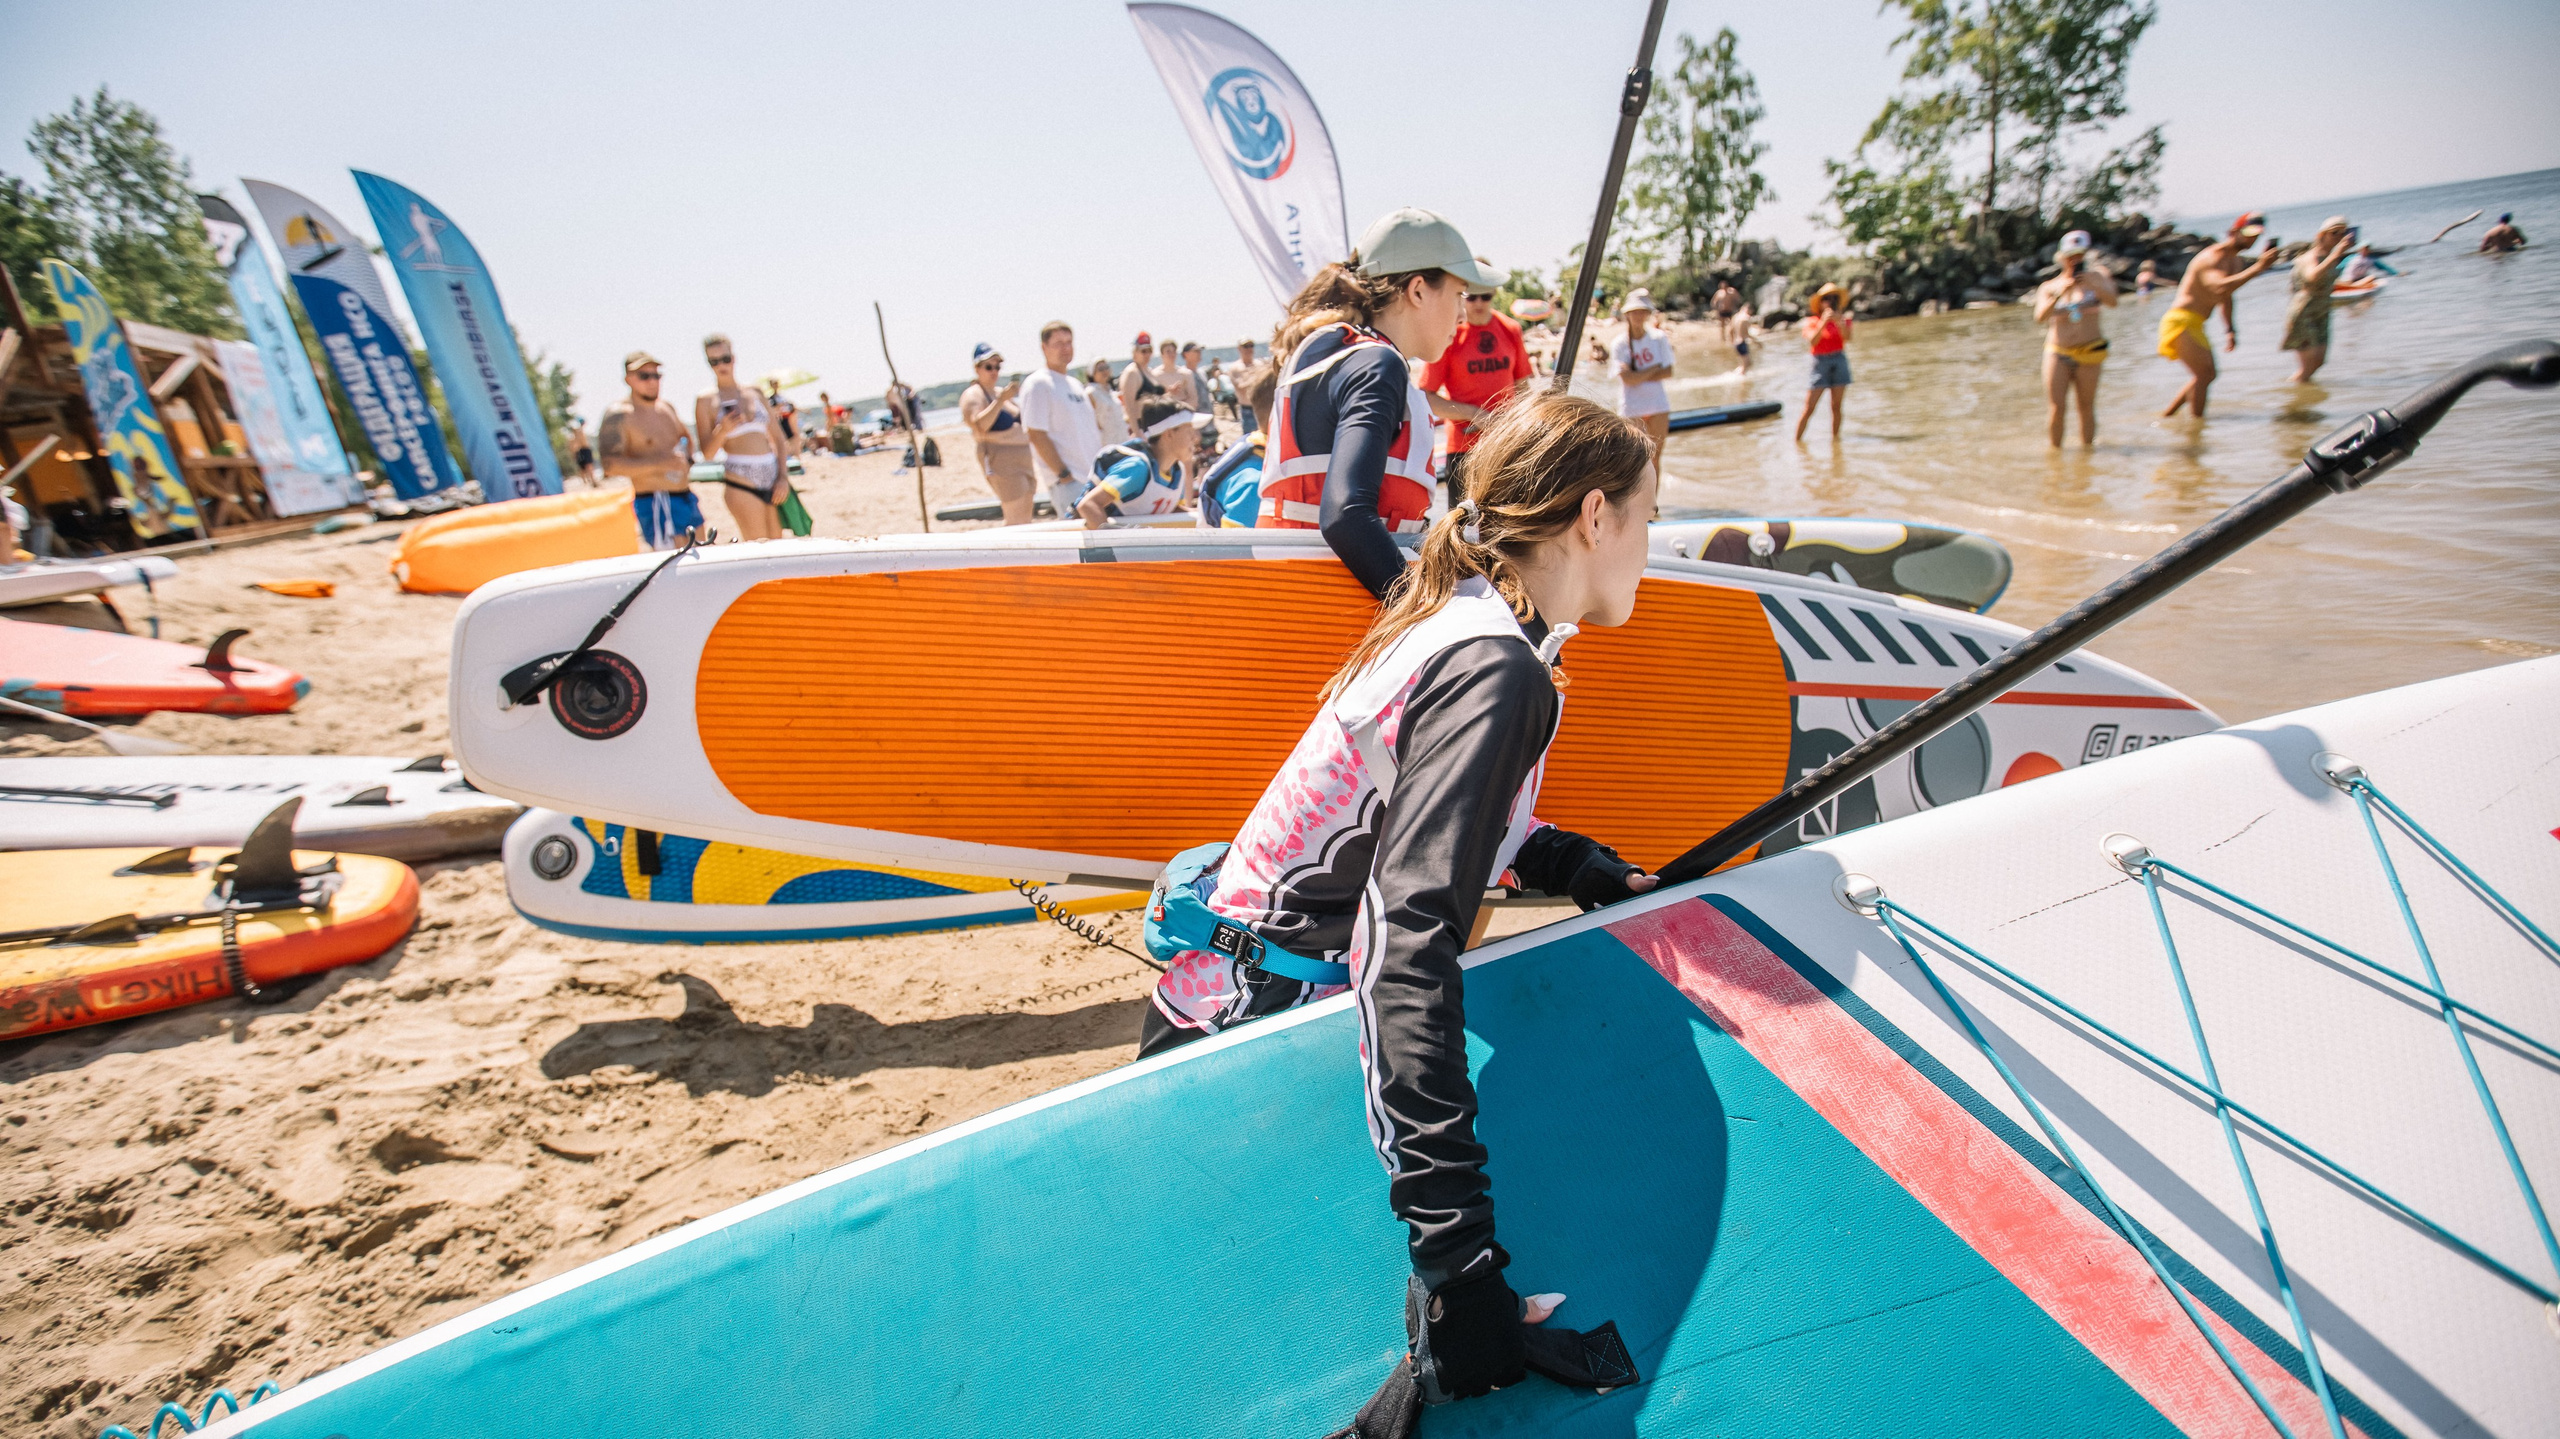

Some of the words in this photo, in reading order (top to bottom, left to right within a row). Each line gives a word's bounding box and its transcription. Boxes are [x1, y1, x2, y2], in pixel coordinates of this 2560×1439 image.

[338, 289, 376, 341] НСО
[323, 330, 406, 462] ФЕДЕРАЦИЯ
[1219, 934, 1231, 945] CE
